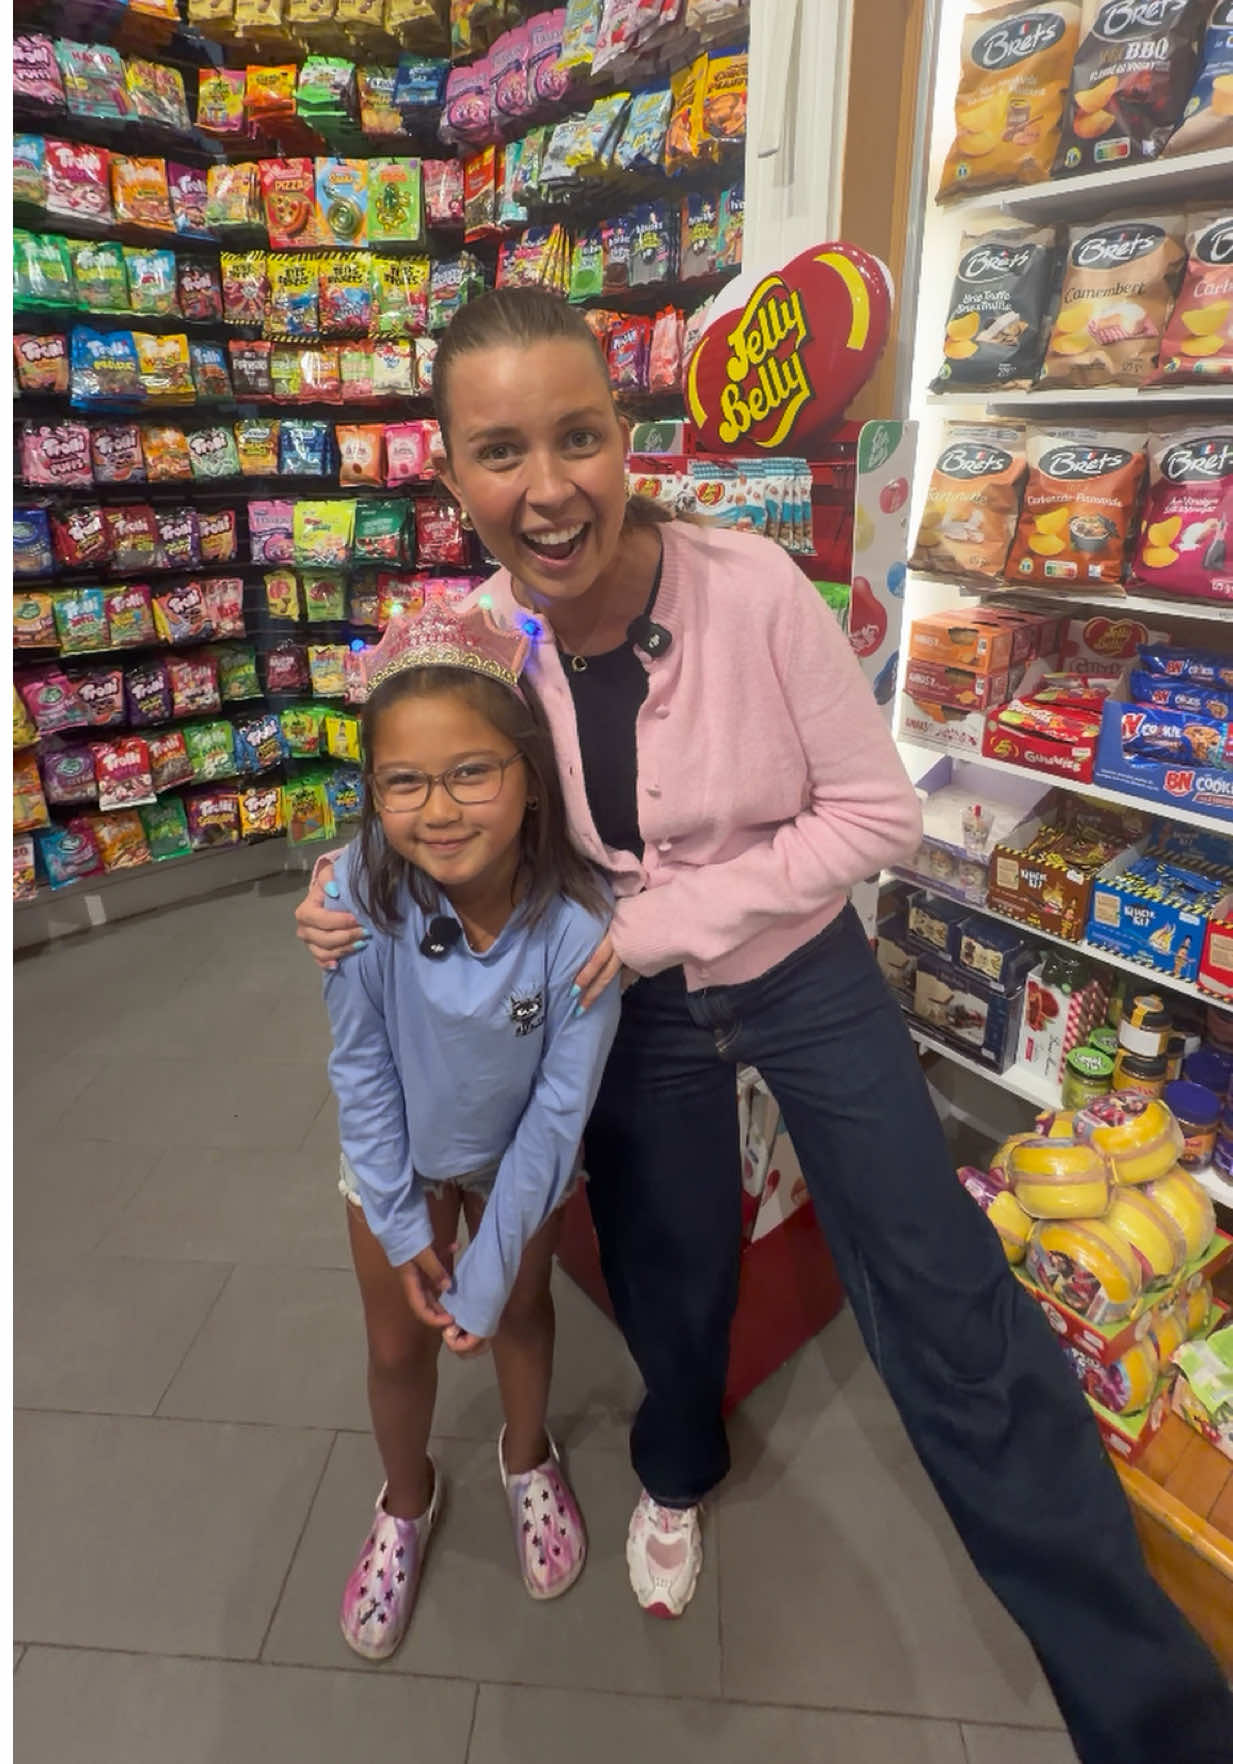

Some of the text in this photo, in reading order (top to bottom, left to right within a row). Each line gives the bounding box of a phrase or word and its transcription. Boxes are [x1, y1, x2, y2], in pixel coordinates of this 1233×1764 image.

[983, 22, 1056, 65] Brets
[1124, 36, 1169, 60] BBQ
[1080, 234, 1155, 268] Brets
[1064, 280, 1147, 304] Camembert
[728, 290, 808, 382] Jelly
[718, 352, 811, 443] Belly
[941, 450, 1005, 474] Brets
[1049, 452, 1123, 475] Brets
[80, 676, 118, 700] Trolli
[103, 752, 142, 771] Trolli
[1165, 771, 1194, 794] BN
[199, 799, 234, 817] Trolli
